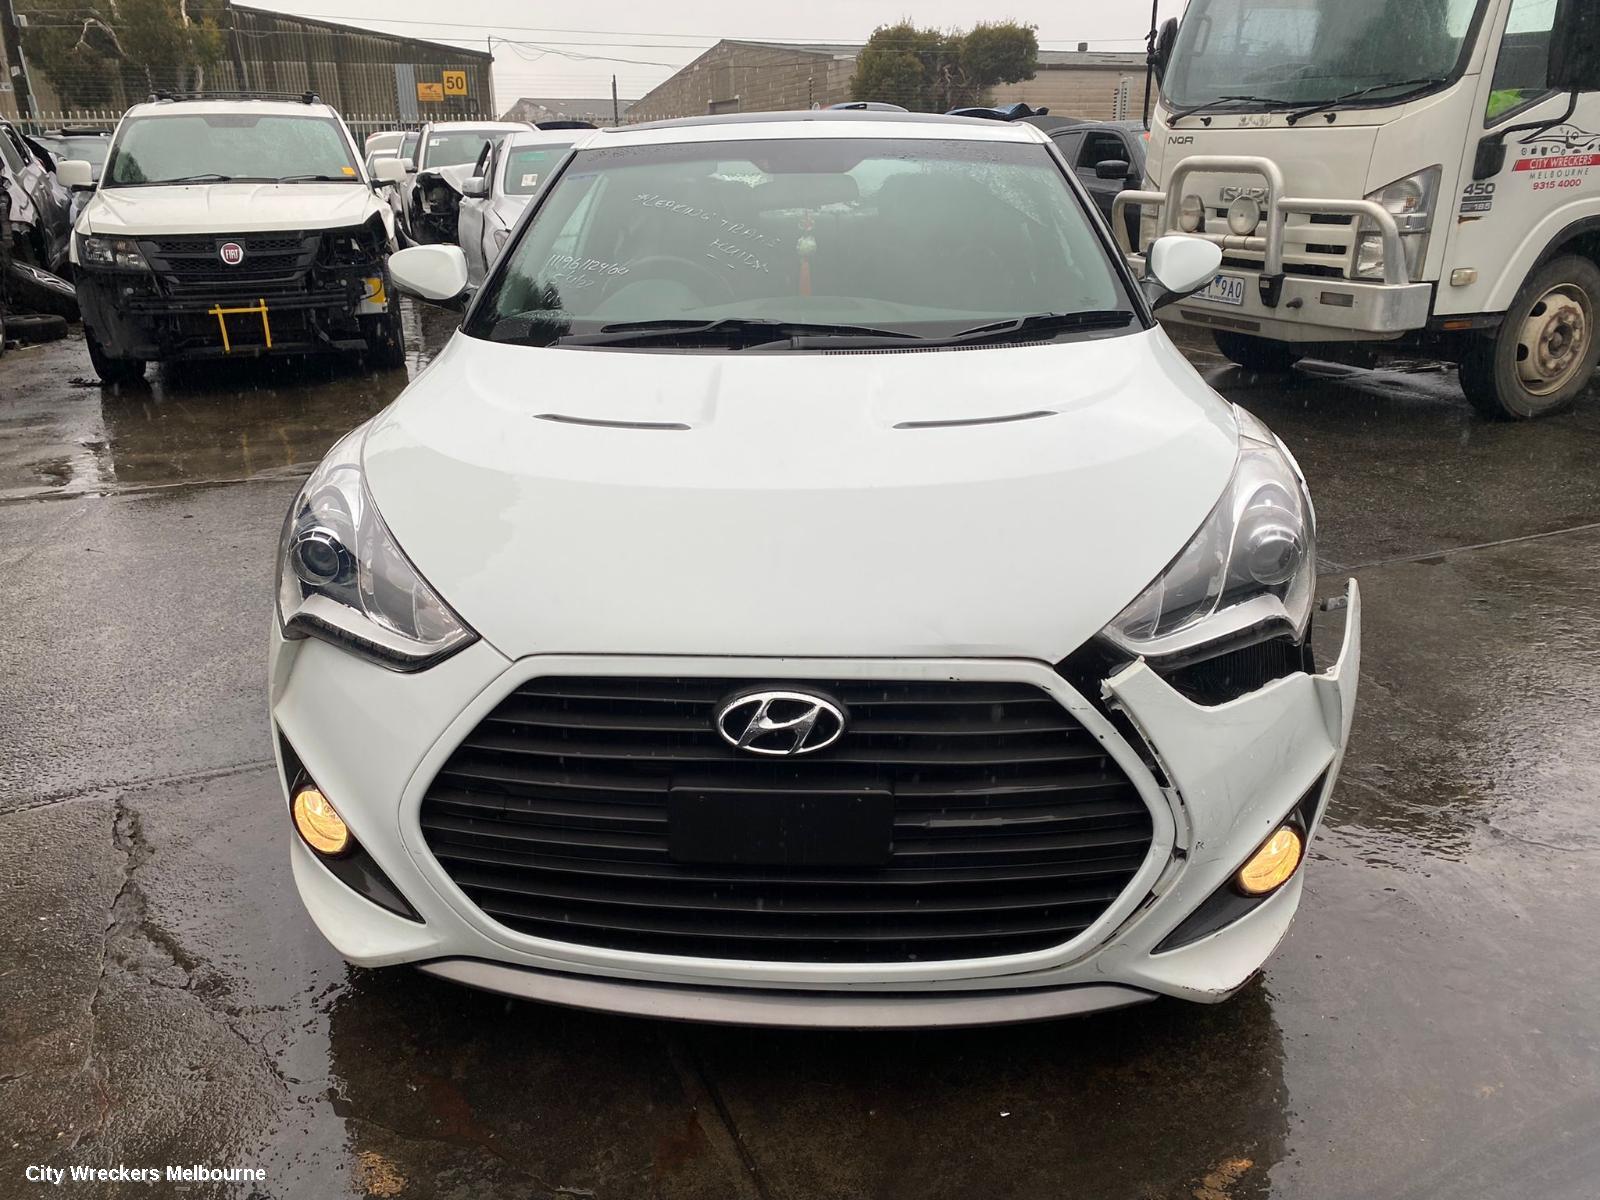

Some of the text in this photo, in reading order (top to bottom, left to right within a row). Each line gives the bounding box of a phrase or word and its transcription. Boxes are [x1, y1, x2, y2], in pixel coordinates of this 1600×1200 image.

[446, 76, 464, 90] 50
[1167, 136, 1194, 145] NQR
[1529, 155, 1593, 169] CITY WRECKERS
[1529, 168, 1589, 180] MELBOURNE
[1463, 182, 1496, 195] 450
[1533, 179, 1582, 191] 9315 4000
[225, 249, 239, 260] FIAT
